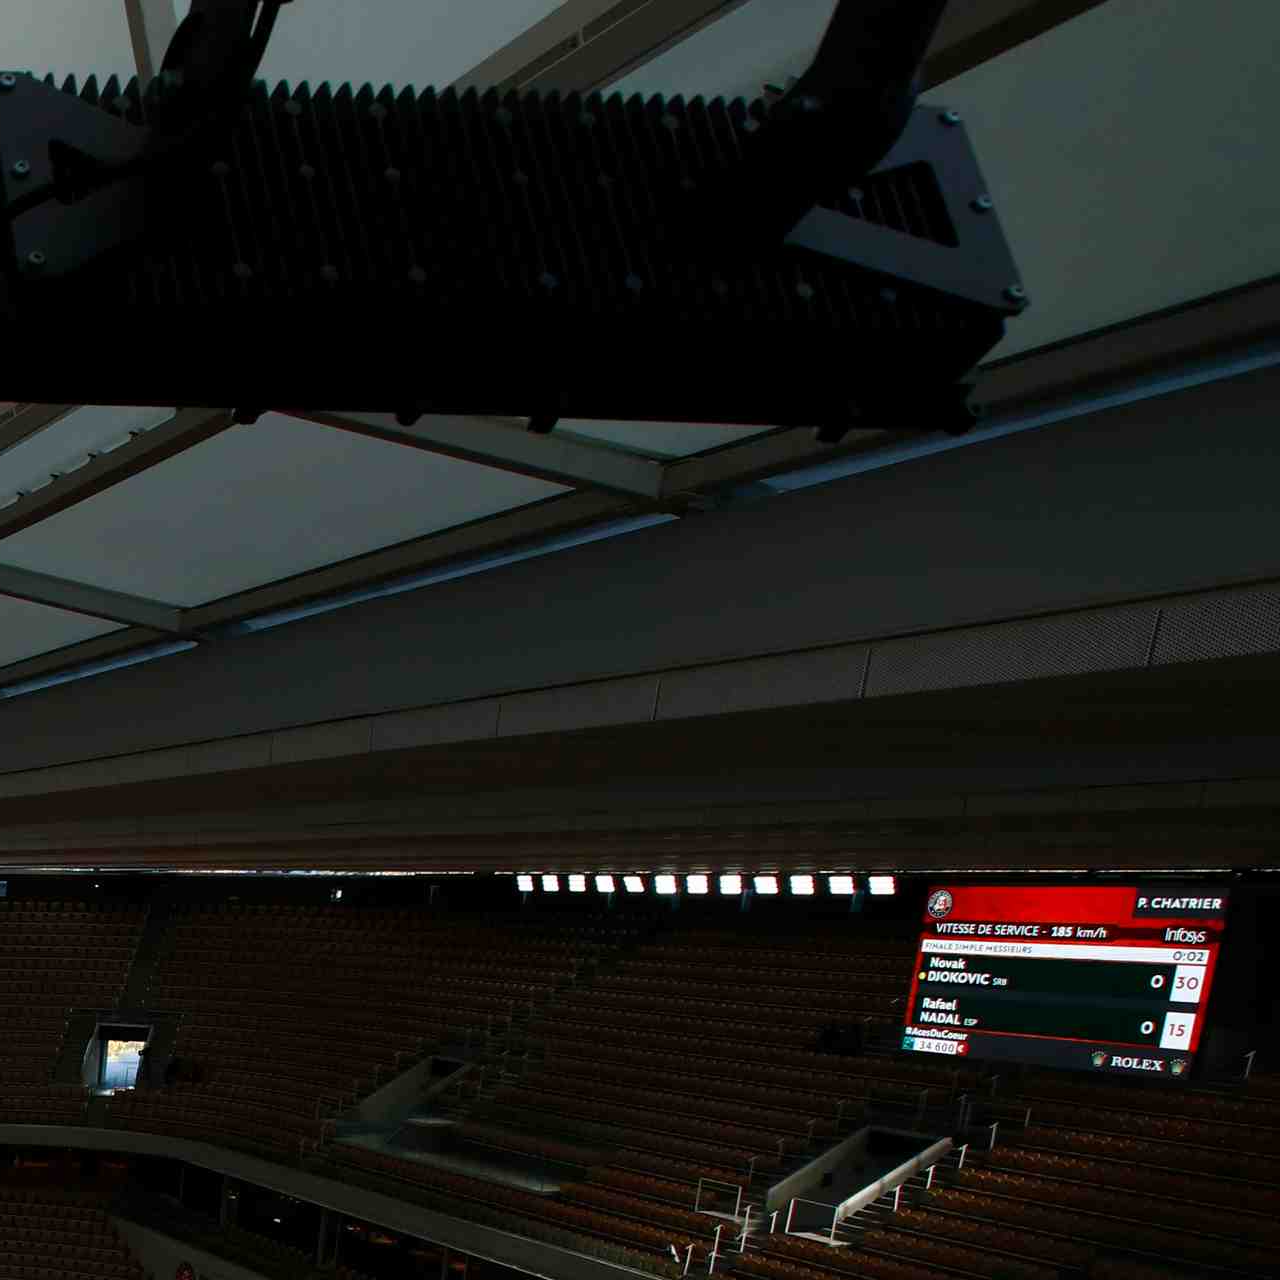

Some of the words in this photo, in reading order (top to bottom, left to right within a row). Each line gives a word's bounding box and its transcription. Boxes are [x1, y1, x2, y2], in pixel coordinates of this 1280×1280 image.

[1137, 898, 1148, 909] P.
[1151, 897, 1222, 910] CHATRIER
[936, 923, 975, 935] VITESSE
[978, 924, 992, 935] DE
[994, 925, 1038, 937] SERVICE
[1050, 926, 1073, 938] 185
[1076, 926, 1107, 939] km/h
[1165, 927, 1207, 943] Infosys
[930, 956, 966, 970] Novak
[1173, 950, 1204, 962] 0:02
[927, 970, 990, 985] DJOKOVIC
[992, 977, 1008, 986] SRB
[1150, 975, 1164, 989] 0
[1176, 977, 1199, 990] 30
[922, 997, 957, 1011] Rafael
[919, 1012, 961, 1026] NADAL
[1140, 1021, 1153, 1035] 0
[1168, 1023, 1186, 1037] 15
[919, 1040, 932, 1050] 34
[935, 1042, 954, 1053] 600
[1111, 1056, 1165, 1072] ROLEX
